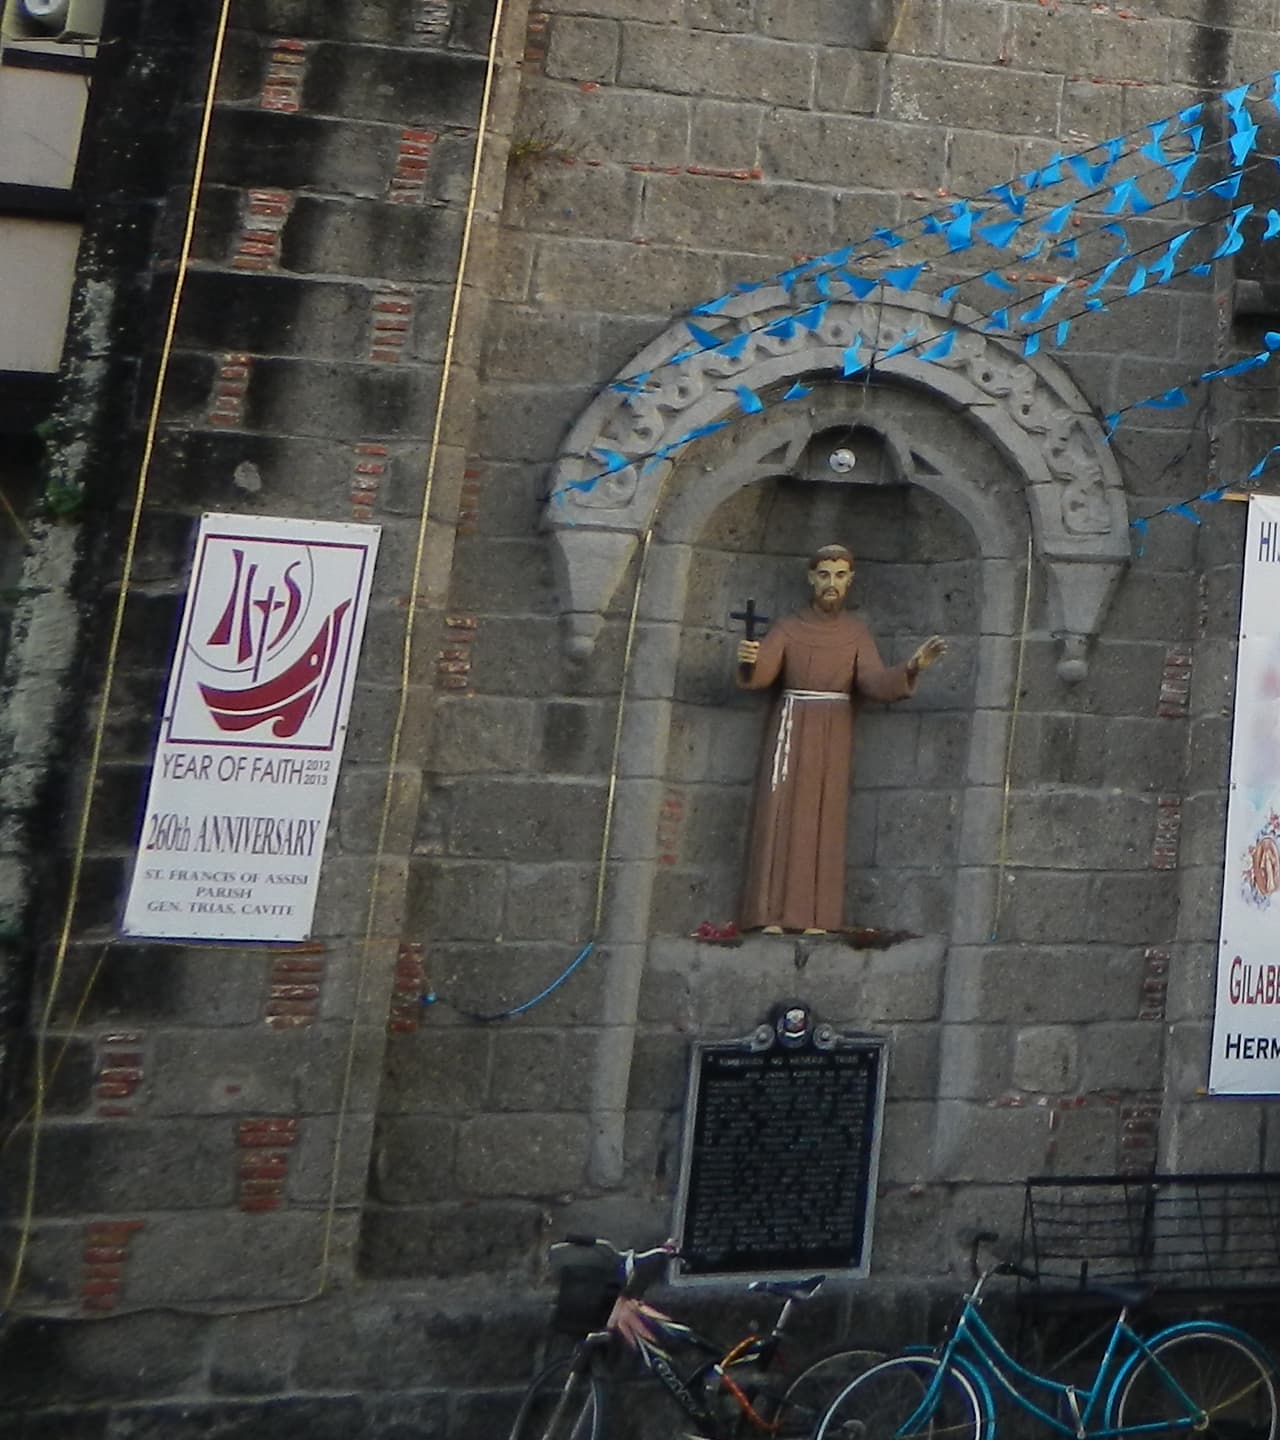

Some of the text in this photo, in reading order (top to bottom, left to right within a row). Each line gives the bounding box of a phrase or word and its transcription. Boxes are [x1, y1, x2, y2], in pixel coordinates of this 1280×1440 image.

[162, 753, 331, 785] YEAR OF FAITH 2012
[303, 774, 328, 786] 2013
[146, 812, 321, 857] 260th ANNIVERSARY
[145, 869, 308, 886] ST. FRANCIS OF ASSISI
[196, 887, 252, 899] PARISH
[241, 904, 294, 917] CAVITE
